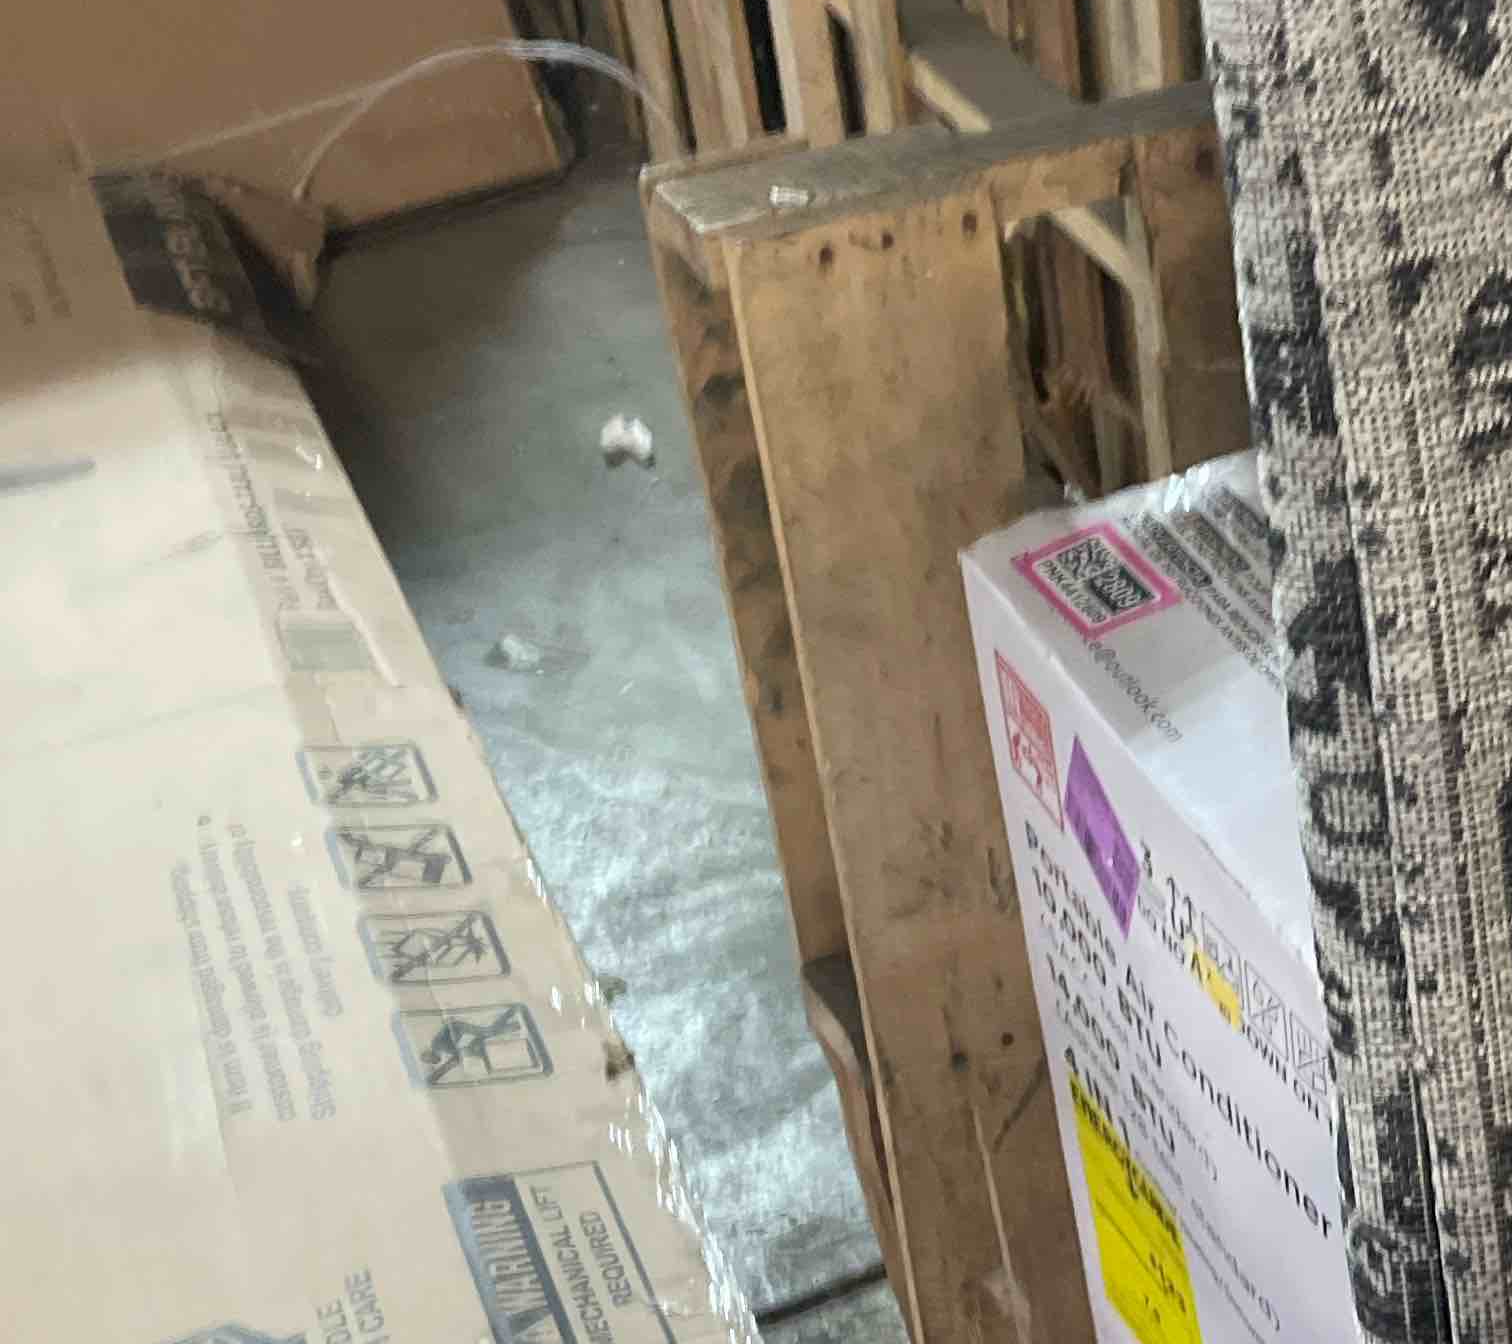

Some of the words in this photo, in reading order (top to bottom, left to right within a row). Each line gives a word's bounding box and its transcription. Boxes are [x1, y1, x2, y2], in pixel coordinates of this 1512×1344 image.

[1025, 819, 1116, 967] Portable
[1126, 964, 1154, 1020] Air
[1164, 1020, 1333, 1238] Conditioner
[1117, 984, 1161, 1068] BTU
[1130, 1072, 1176, 1154] BTU
[528, 1183, 565, 1223] LIFT
[469, 1199, 550, 1314] WARNING
[579, 1211, 633, 1308] REQUIRED
[344, 1268, 386, 1335] CARE
